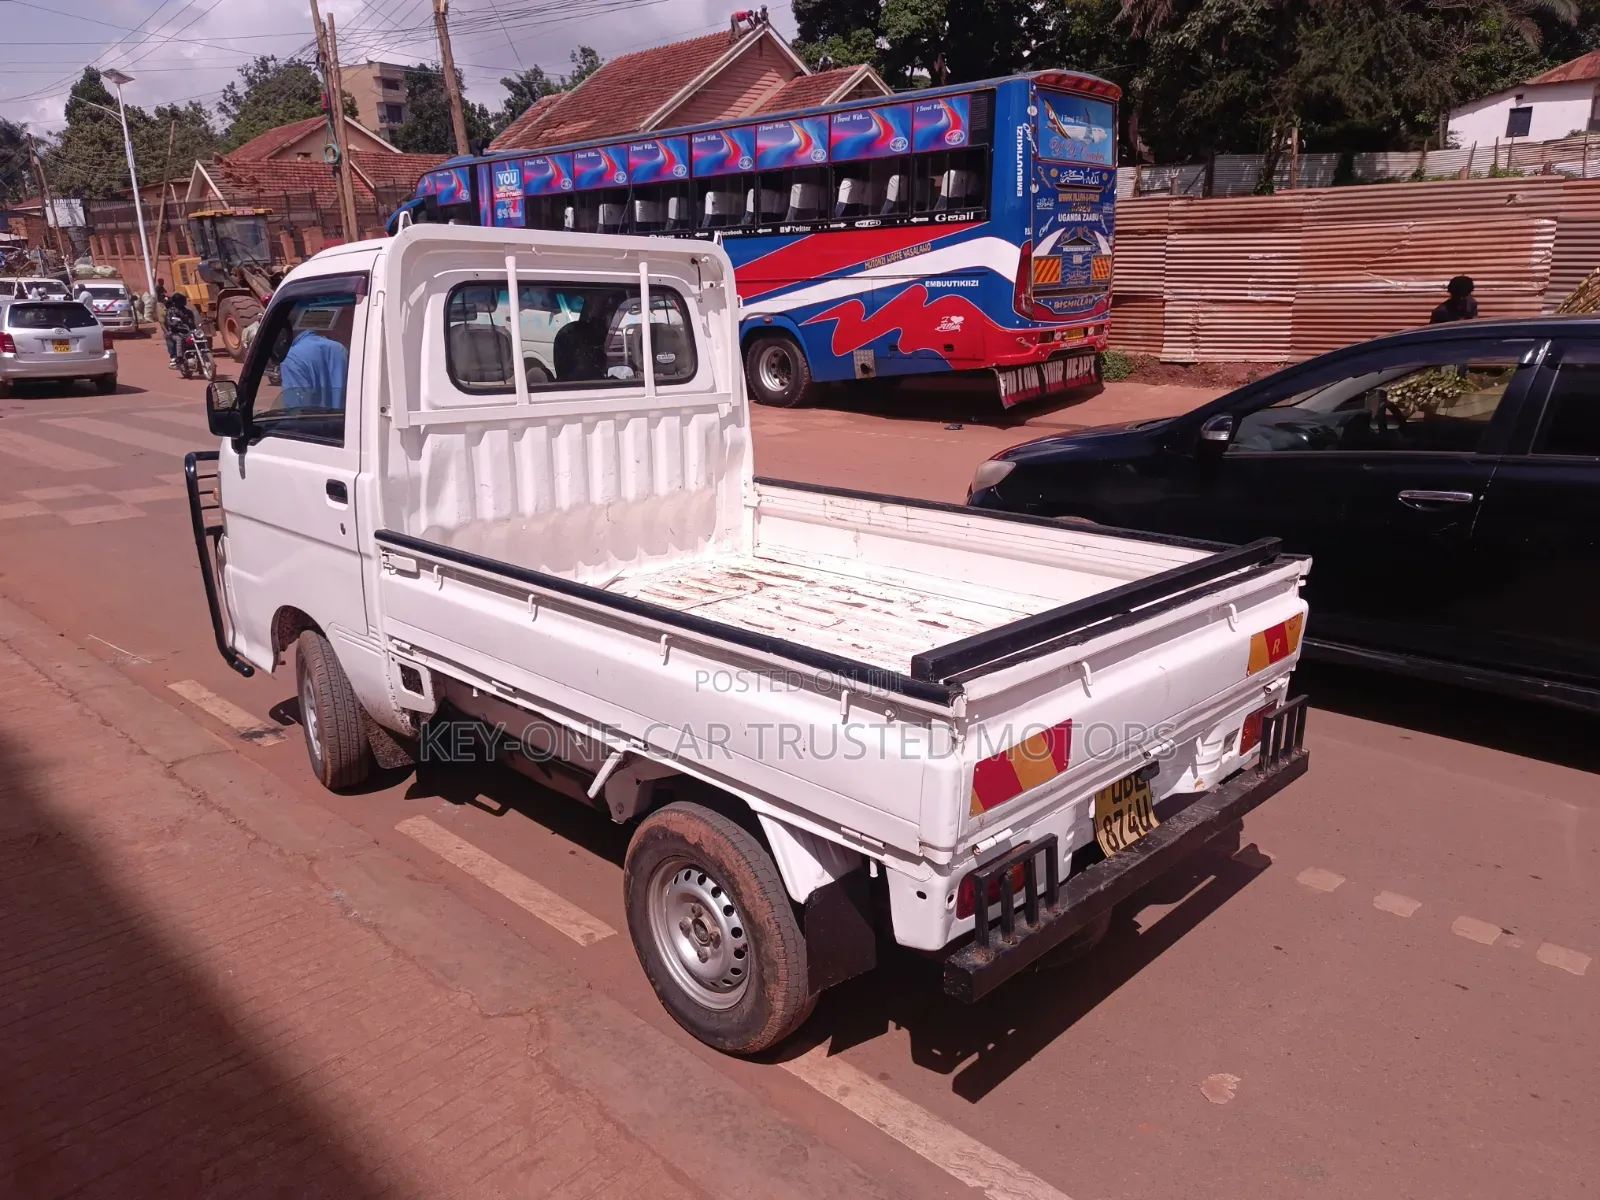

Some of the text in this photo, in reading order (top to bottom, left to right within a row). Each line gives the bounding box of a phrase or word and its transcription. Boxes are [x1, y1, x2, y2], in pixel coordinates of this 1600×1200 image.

[497, 171, 517, 185] YOU
[934, 211, 974, 223] Gmail
[791, 225, 812, 233] Twitter
[924, 279, 979, 288] EMBUUTIKIIZI
[1272, 637, 1281, 656] R
[1102, 794, 1153, 853] 874U
